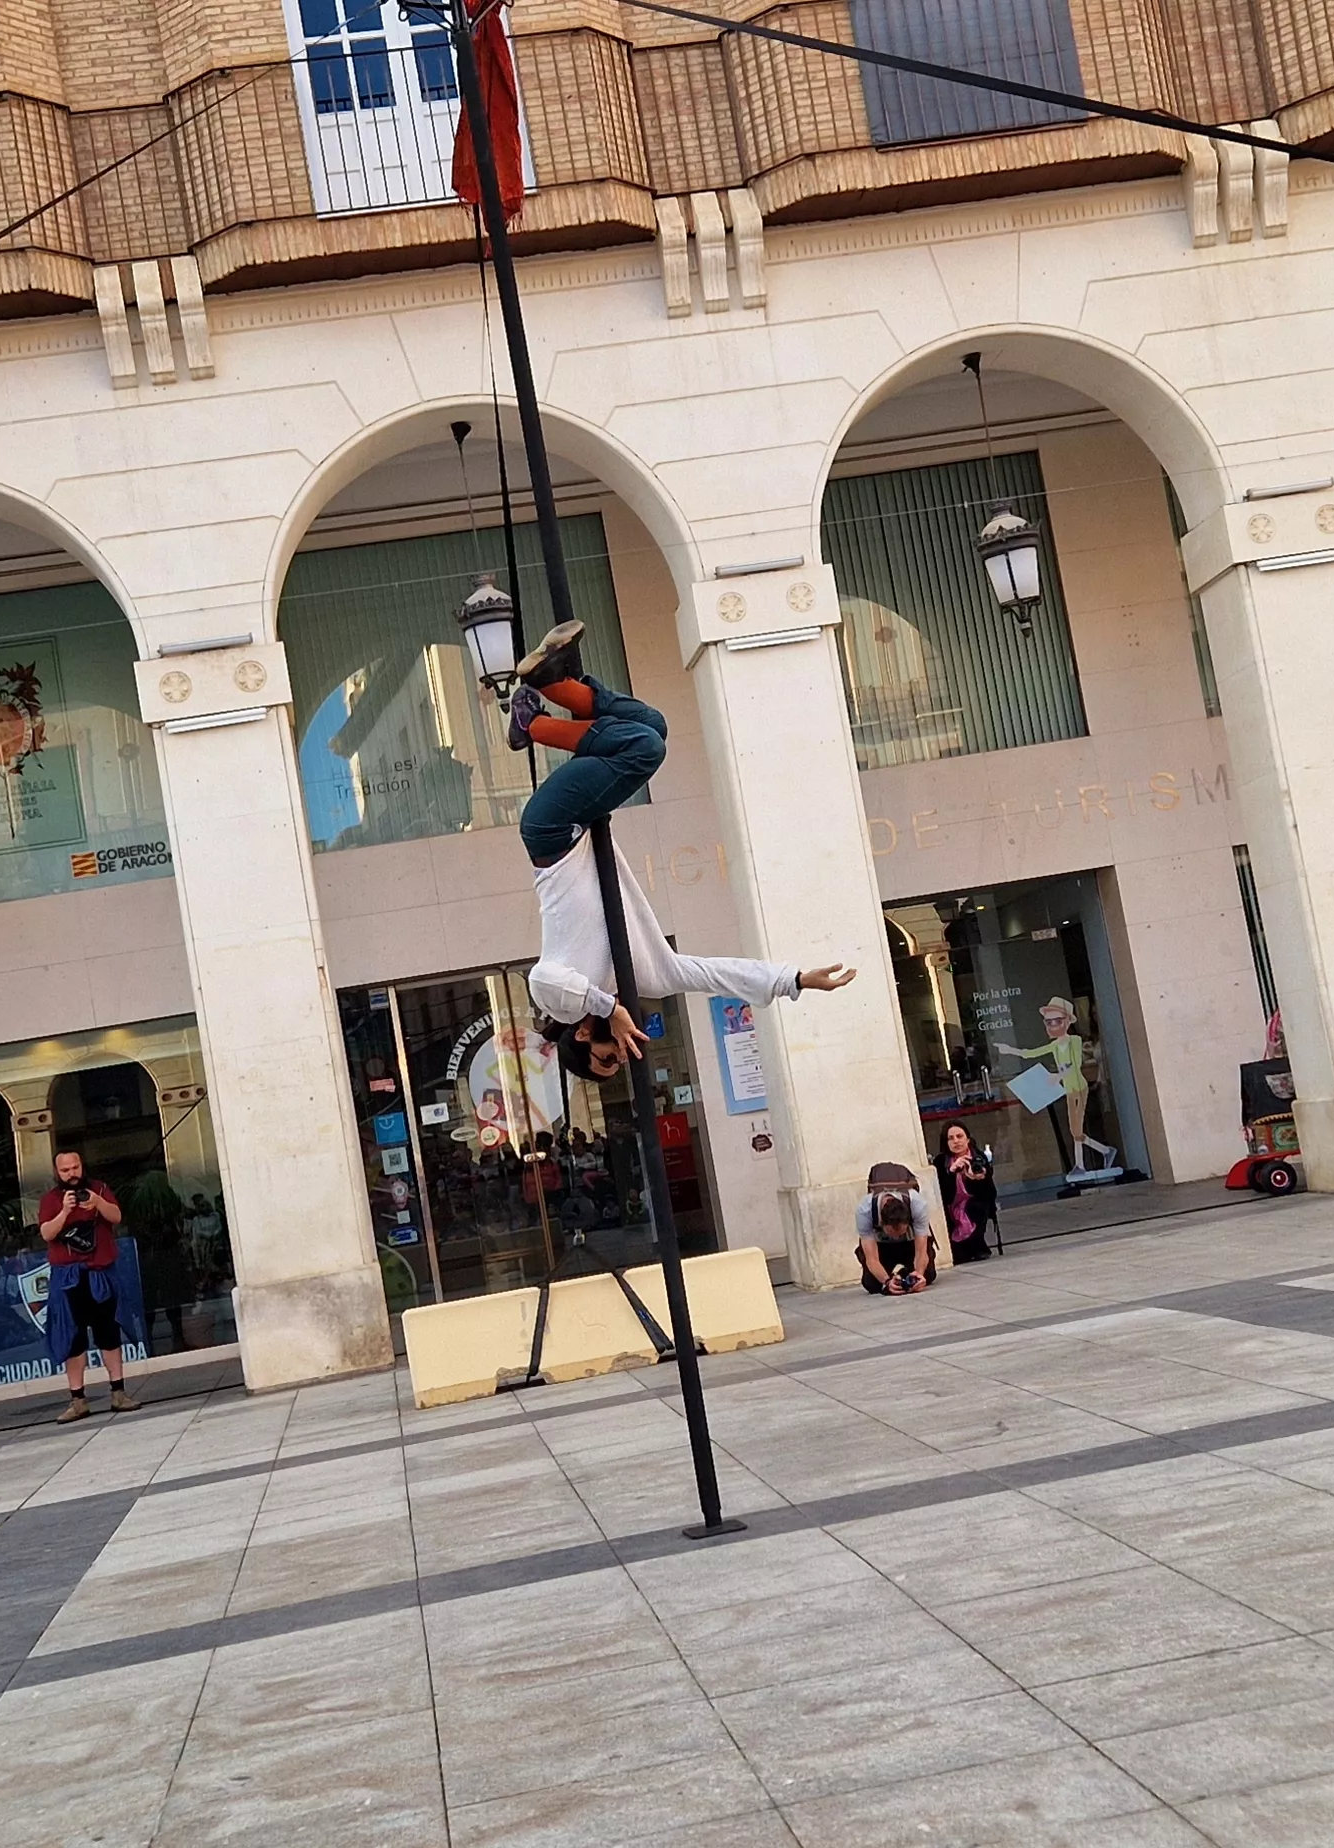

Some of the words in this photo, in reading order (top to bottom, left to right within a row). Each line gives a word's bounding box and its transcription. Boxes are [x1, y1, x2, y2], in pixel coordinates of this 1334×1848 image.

[334, 776, 411, 799] Tradición
[866, 808, 945, 857] DE
[988, 762, 1231, 836] TURISM
[96, 841, 166, 861] GOBIERNO
[98, 860, 116, 874] DE
[972, 991, 989, 1003] Por
[990, 989, 1000, 999] la
[1001, 987, 1022, 998] otra
[977, 1017, 1014, 1031] Gracias
